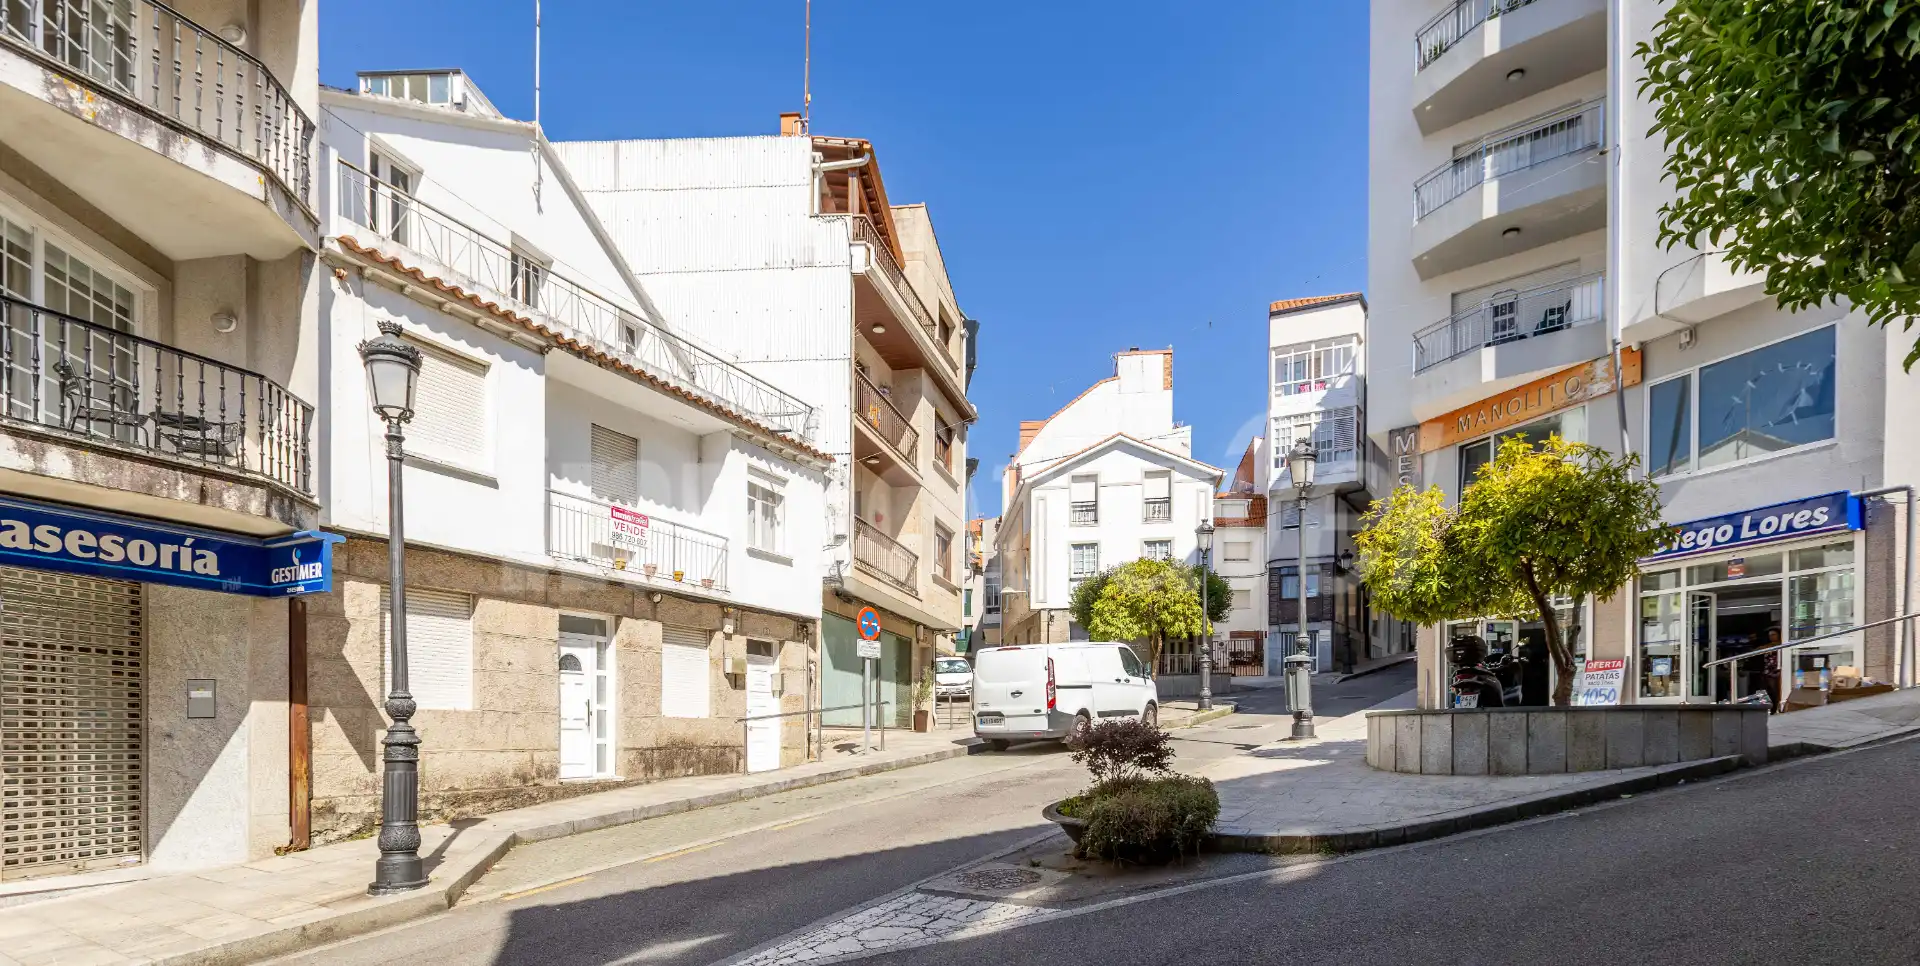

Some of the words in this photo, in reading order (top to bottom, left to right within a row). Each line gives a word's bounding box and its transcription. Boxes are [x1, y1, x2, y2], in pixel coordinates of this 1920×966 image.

[1456, 375, 1581, 433] MANOLITO
[614, 521, 645, 537] VENDE
[1653, 524, 1734, 552] iego
[1740, 506, 1829, 539] Lores
[0, 519, 220, 576] asesoría
[271, 561, 323, 584] GESTIMER
[1587, 661, 1621, 669] OFERTA
